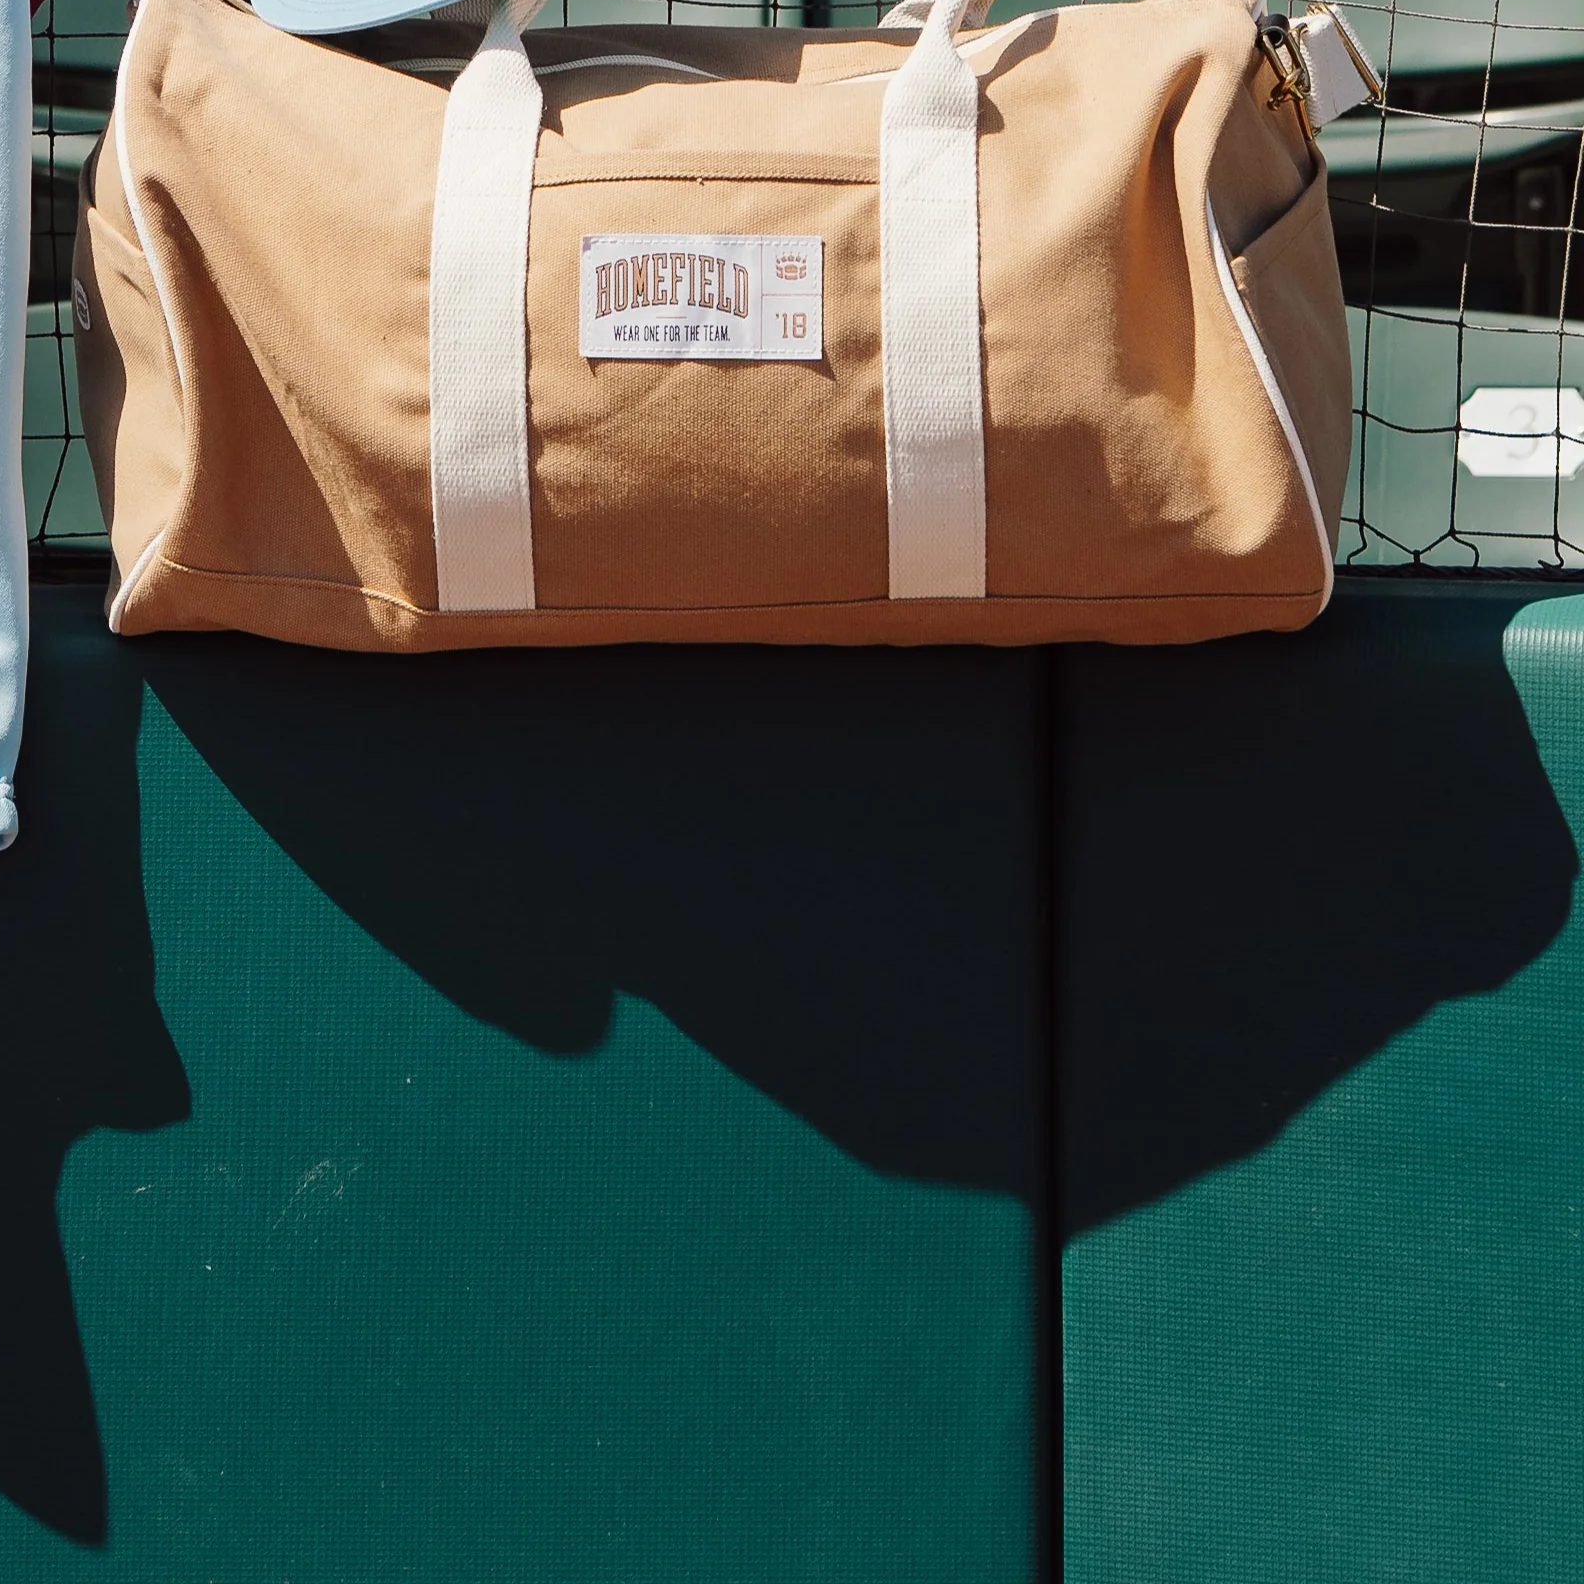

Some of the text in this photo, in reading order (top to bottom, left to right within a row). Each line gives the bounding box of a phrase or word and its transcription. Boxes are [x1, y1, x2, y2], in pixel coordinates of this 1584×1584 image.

[595, 252, 749, 320] HOMEFIELD
[614, 325, 731, 342] WEAR ONE FOR THE TEAM.
[1506, 402, 1538, 460] 3
